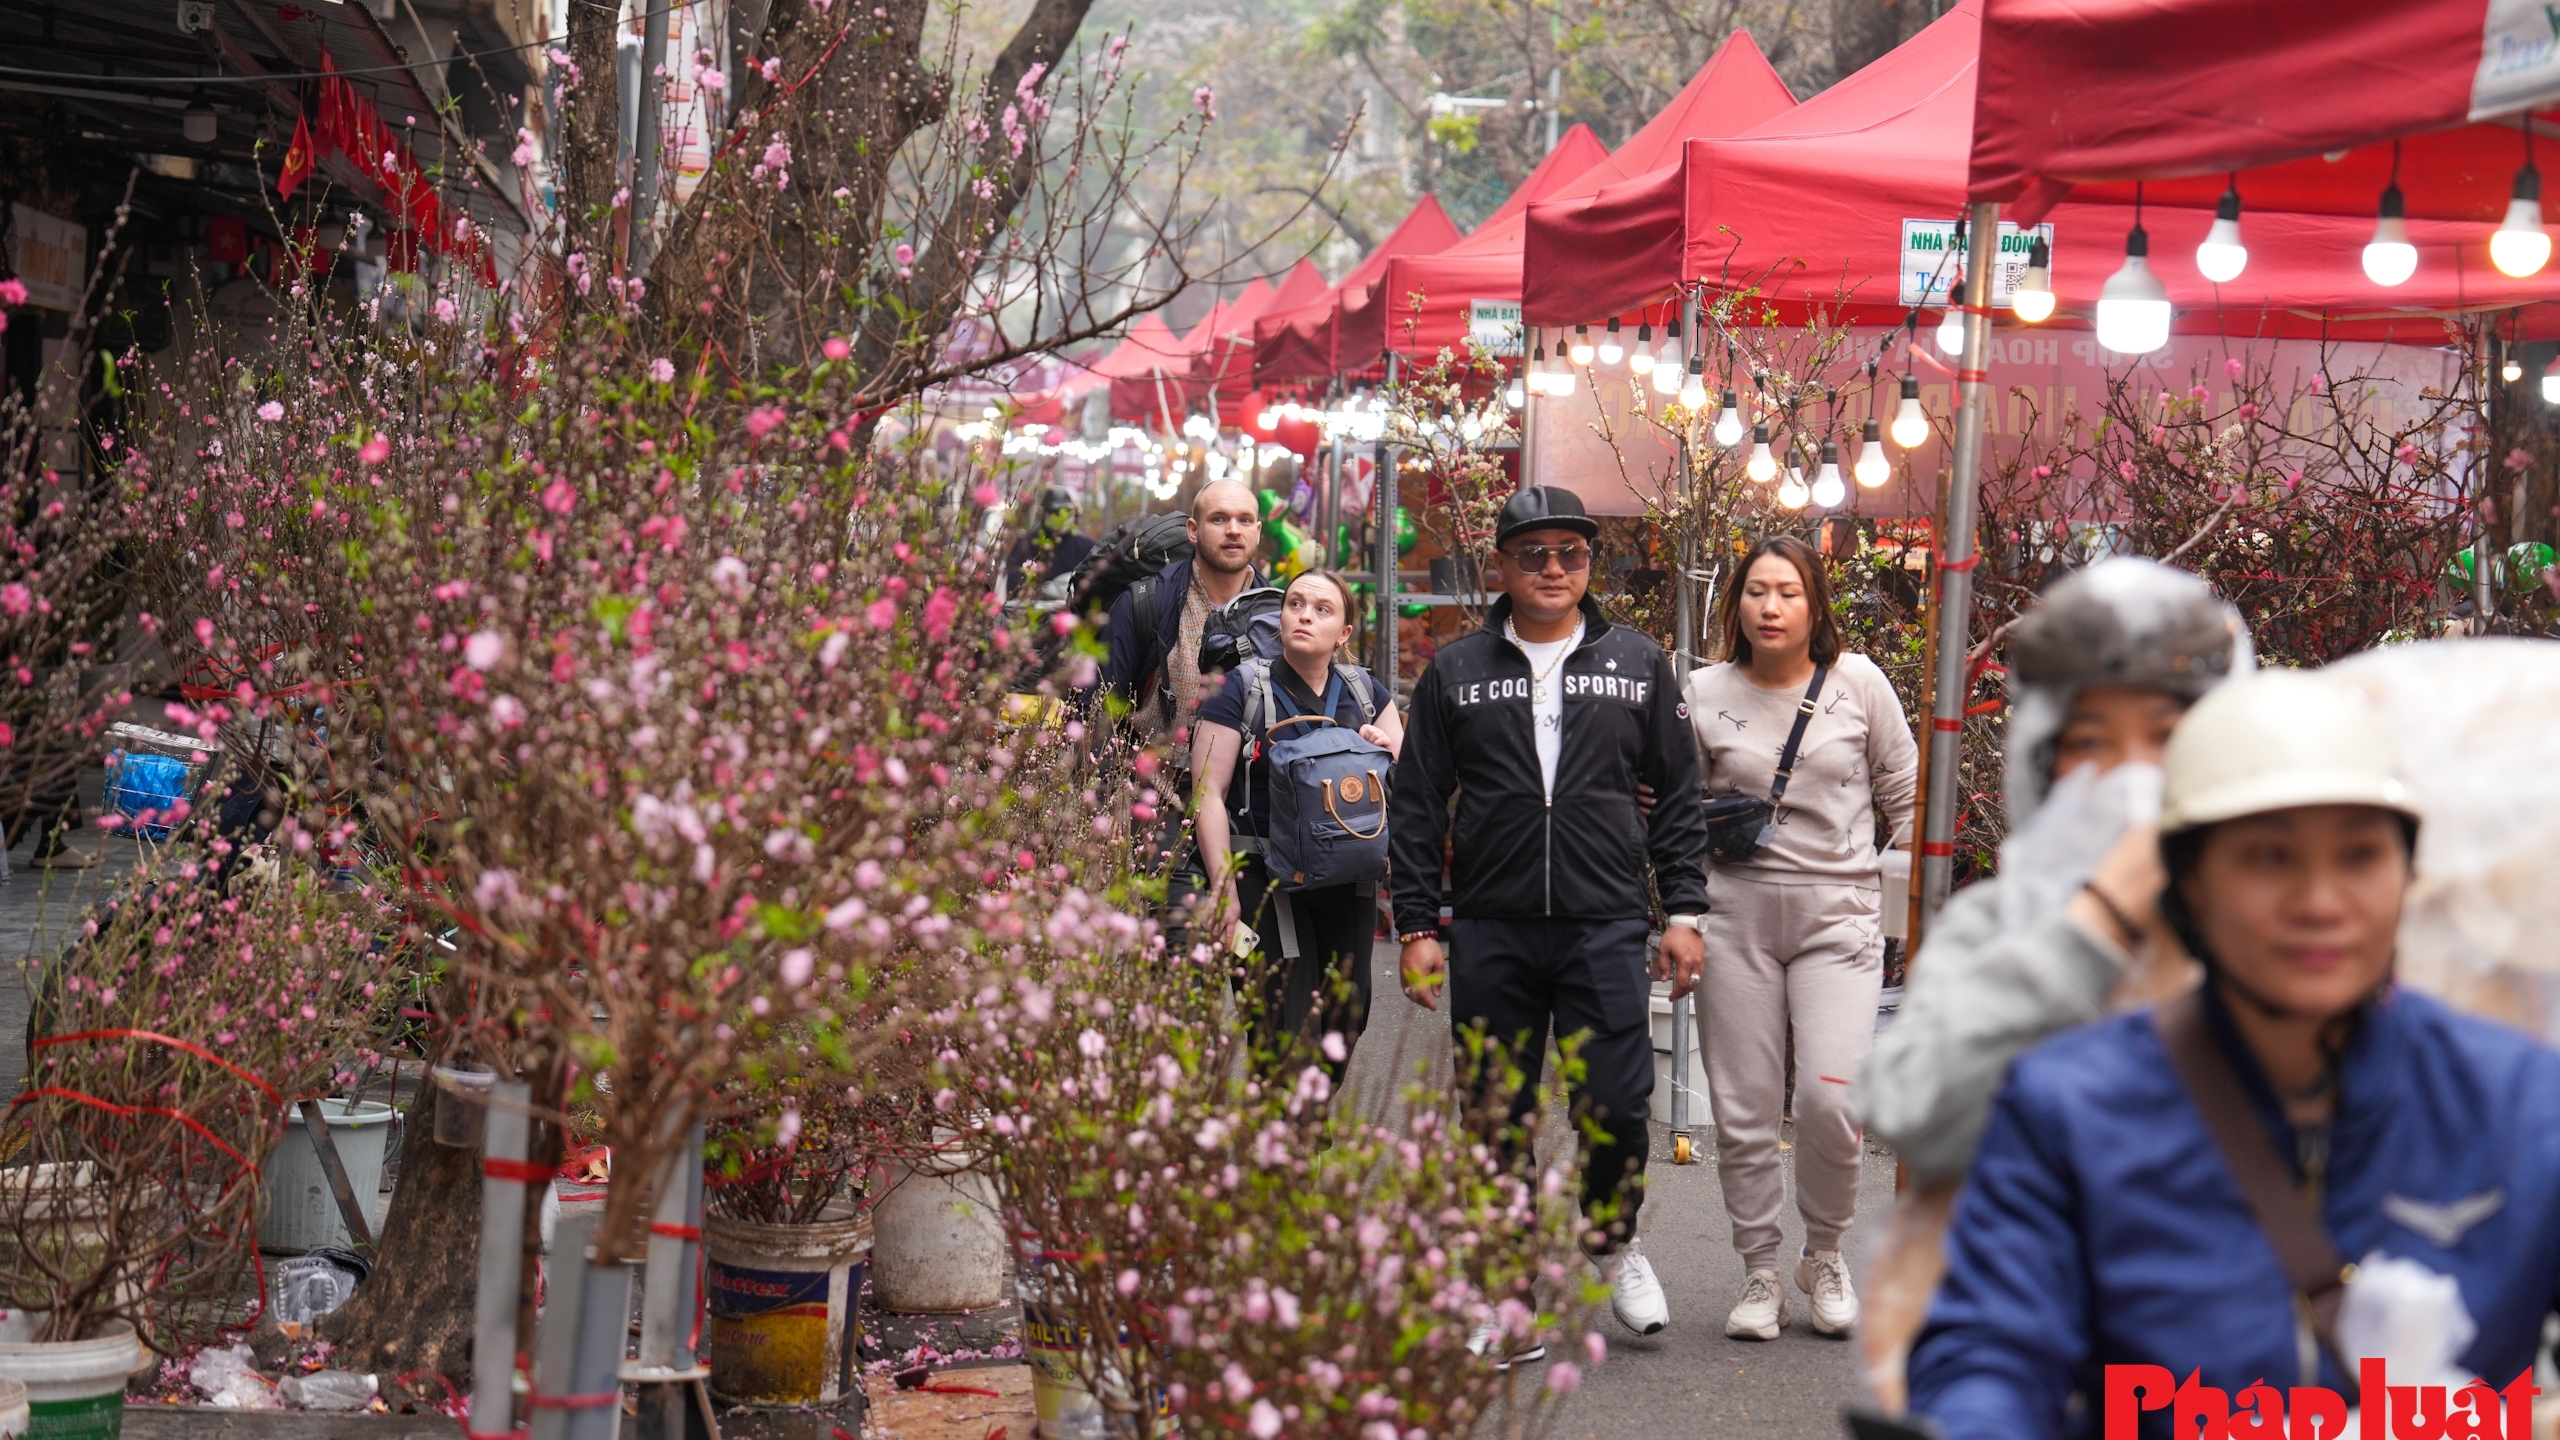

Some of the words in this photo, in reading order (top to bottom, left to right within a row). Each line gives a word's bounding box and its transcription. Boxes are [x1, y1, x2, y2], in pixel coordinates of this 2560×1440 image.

[1911, 229, 1943, 250] NHÀ
[1949, 234, 1969, 255] BẠ
[1478, 306, 1498, 320] NHÀ
[1458, 684, 1481, 706] LE
[1489, 677, 1529, 700] COQ
[1565, 674, 1648, 703] SPORTIF
